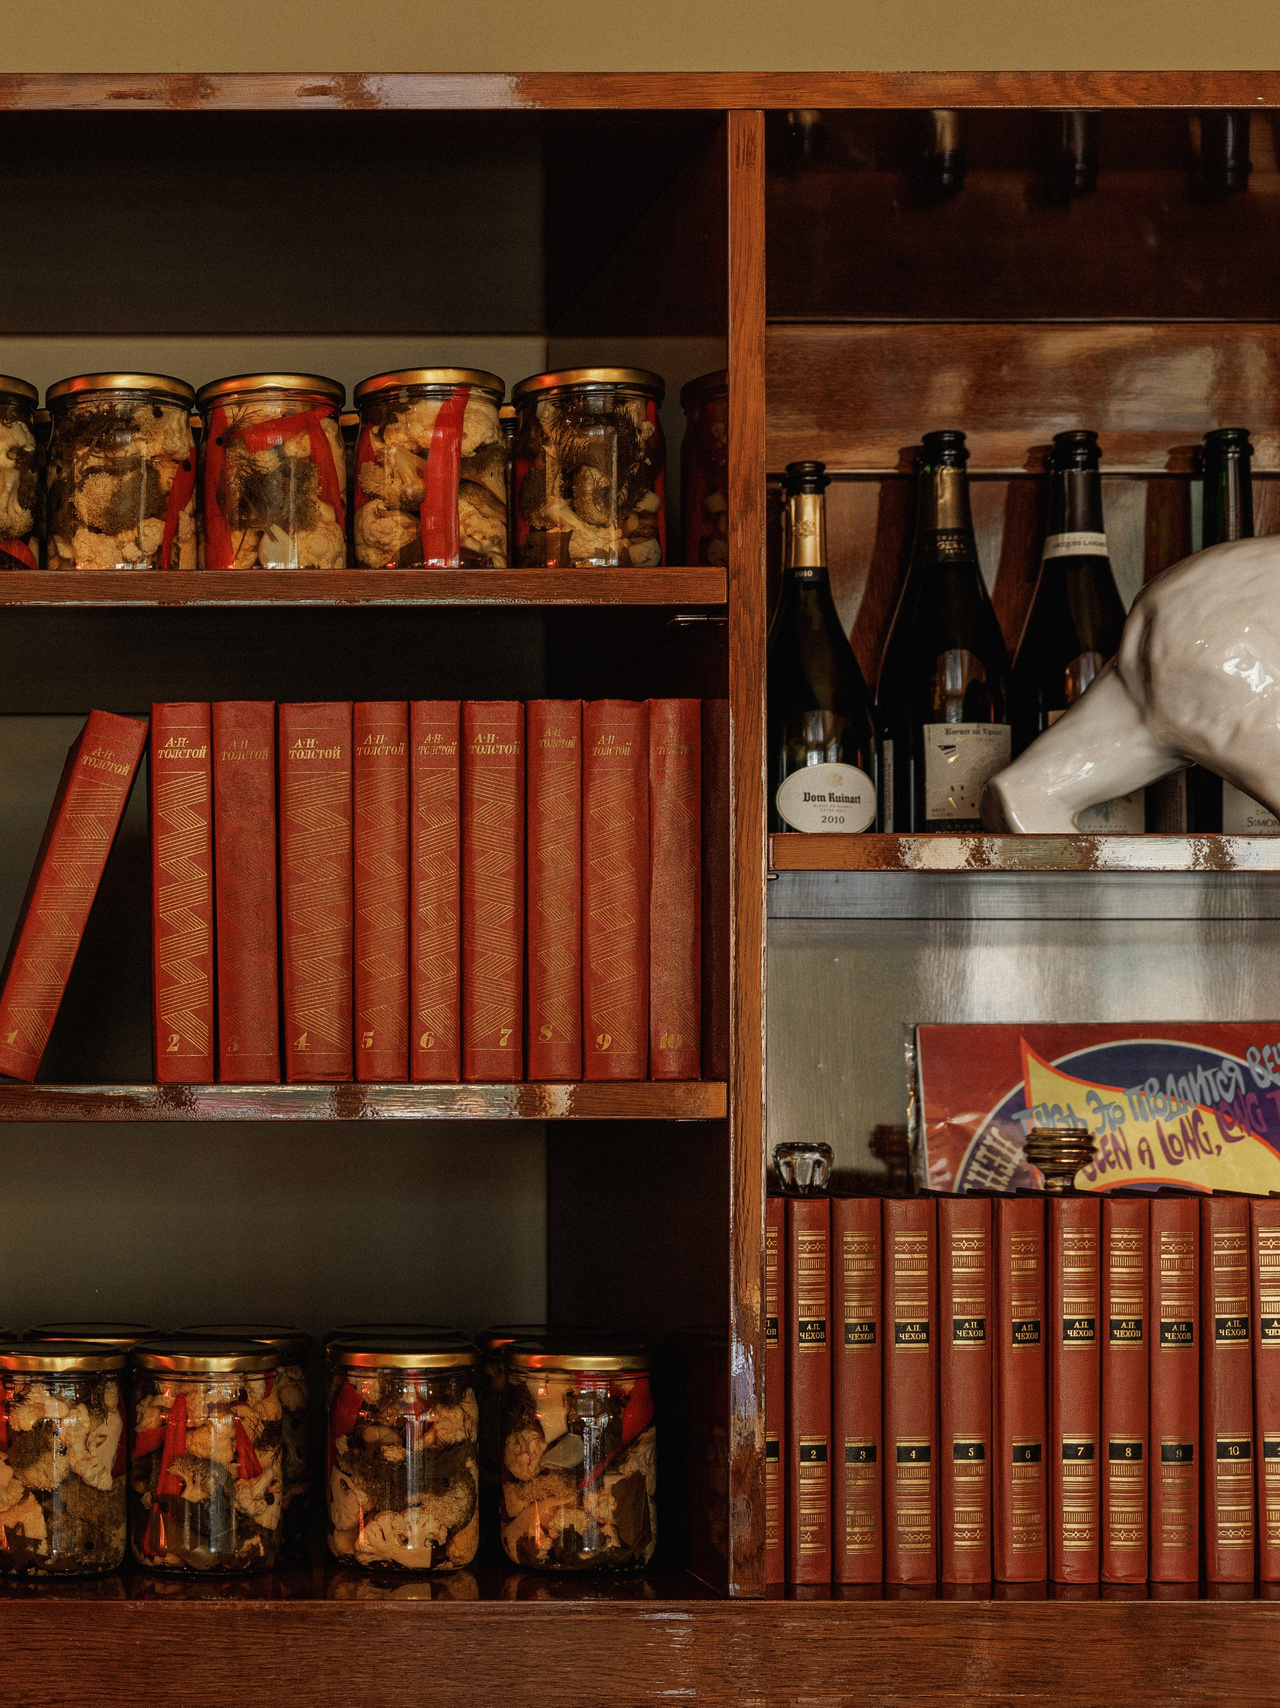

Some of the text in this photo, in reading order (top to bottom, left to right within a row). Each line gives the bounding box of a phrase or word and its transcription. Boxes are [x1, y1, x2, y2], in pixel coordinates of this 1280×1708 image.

[794, 570, 813, 578] 2010
[418, 742, 457, 755] ТОЛСТОЙ
[469, 741, 521, 755] ТОЛСТОЙ
[538, 735, 577, 749] ТОЛСТОЙ
[157, 745, 207, 759] ТОЛСТОЙ
[220, 747, 269, 761] ТОЛСТОЙ
[288, 747, 341, 760] ТОЛСТОЙ
[356, 742, 405, 756] ТОЛСТОЙ
[592, 742, 632, 757] ТОЛСТОЙ
[83, 755, 131, 777] ТОЛСТОЙ
[803, 792, 861, 804] Dom Ruinart
[821, 815, 845, 824] 2010
[5, 1029, 19, 1045] 1
[499, 1028, 513, 1047] 7
[538, 1024, 553, 1041] 8
[166, 1033, 181, 1052] 2
[293, 1032, 311, 1051] 4
[361, 1030, 375, 1049] 5
[420, 1031, 435, 1049] 6
[596, 1033, 612, 1050] 9
[1086, 1090, 1125, 1134] ЭТО
[1123, 1059, 1245, 1122] ПРОДЛИТСЯ
[1137, 1137, 1155, 1170] A
[1213, 1088, 1268, 1143] LONG
[963, 1126, 1023, 1191] ЛЕН
[956, 1329, 984, 1337] ЧЕХОВ
[1015, 1332, 1039, 1340] ЧЕХОВ
[1067, 1329, 1094, 1337] ЧЕХОВ
[1113, 1330, 1141, 1338] ЧЕХОВ
[1165, 1332, 1192, 1340] ЧЕХОВ
[810, 1450, 817, 1459] 2
[859, 1451, 866, 1460] 3
[909, 1450, 916, 1459] 4
[968, 1447, 974, 1456] 5
[1025, 1450, 1031, 1459] 6
[1077, 1447, 1084, 1456] 7
[1125, 1447, 1132, 1457] 8
[1228, 1446, 1240, 1455] 10
